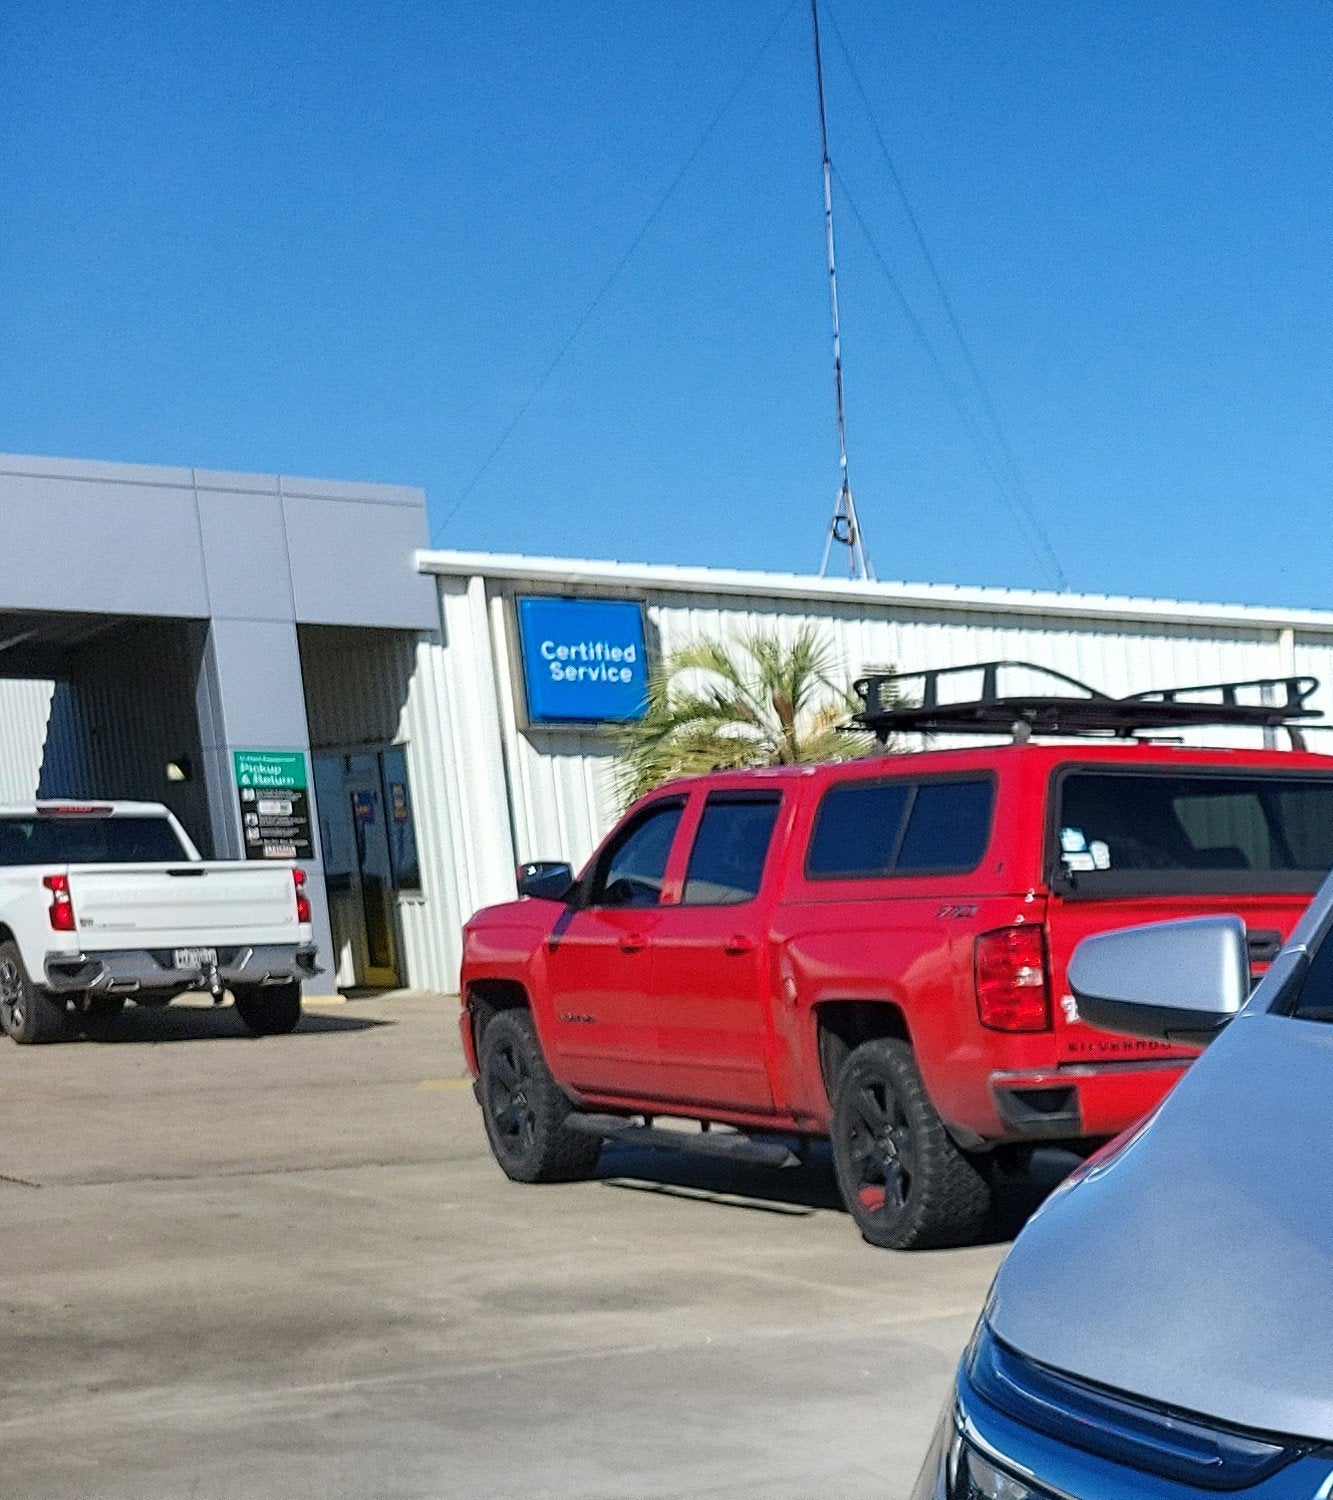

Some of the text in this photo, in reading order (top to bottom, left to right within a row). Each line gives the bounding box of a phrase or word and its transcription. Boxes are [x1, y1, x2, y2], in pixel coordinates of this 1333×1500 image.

[541, 640, 637, 663] Certified
[549, 661, 633, 683] Service
[240, 762, 282, 775] Pickup
[253, 773, 295, 786] Return
